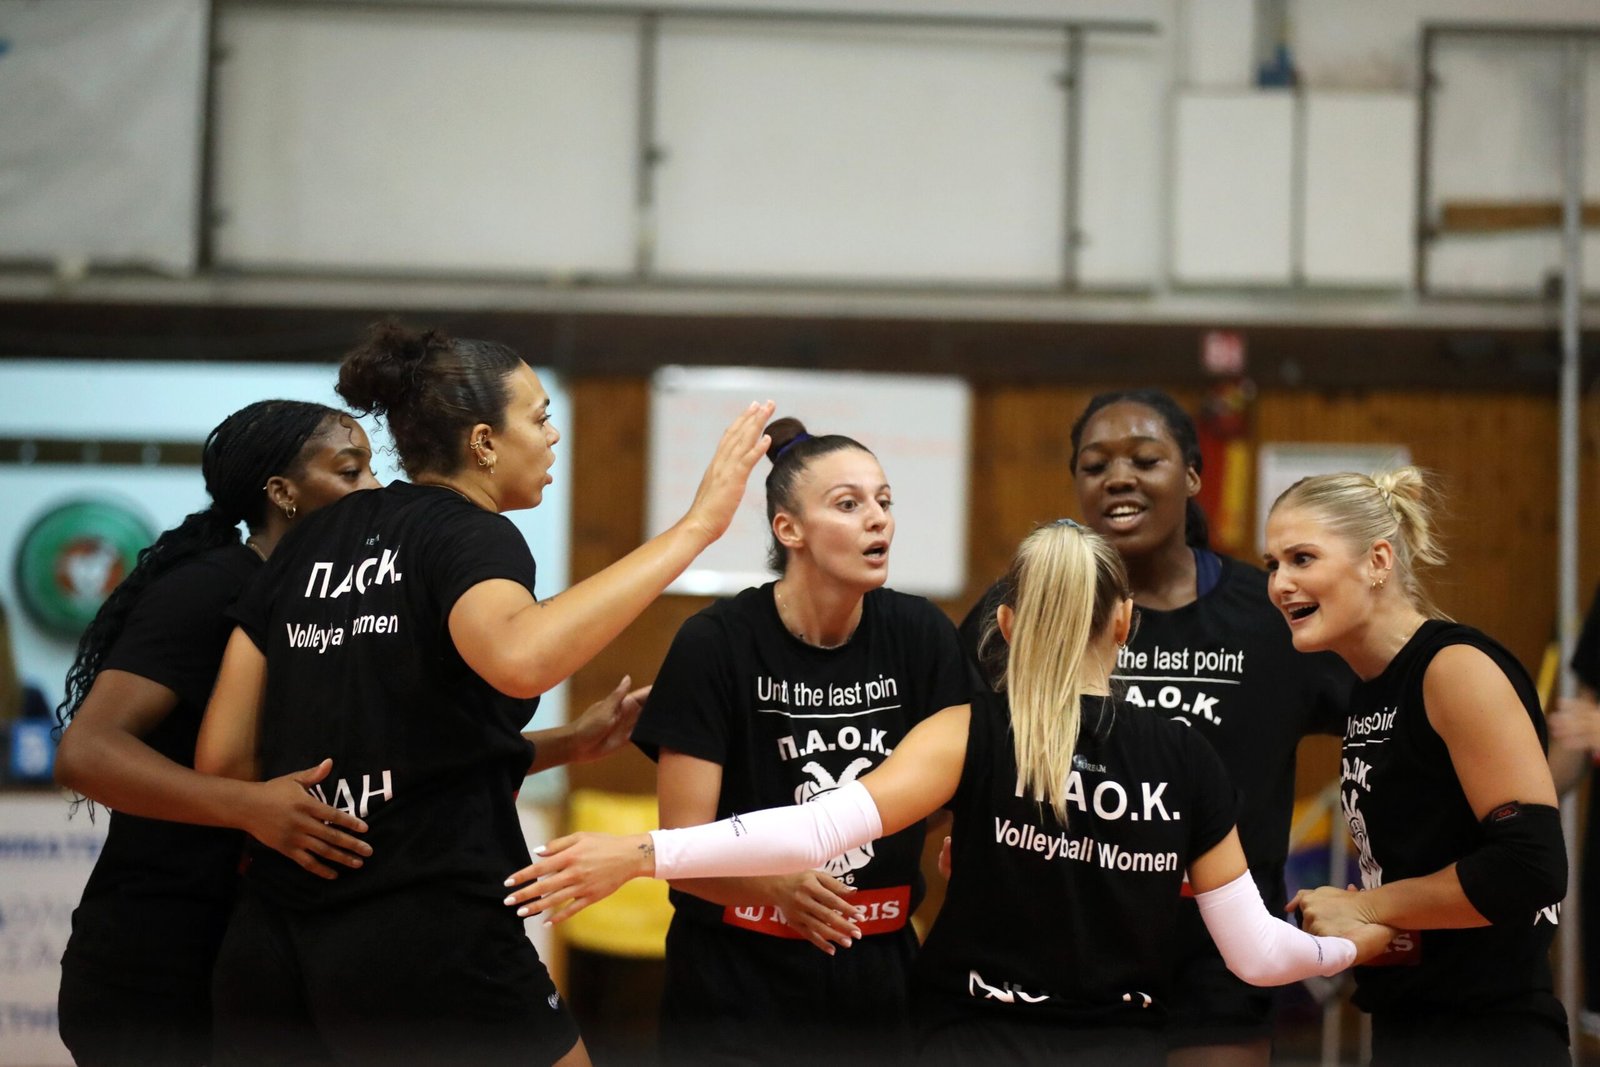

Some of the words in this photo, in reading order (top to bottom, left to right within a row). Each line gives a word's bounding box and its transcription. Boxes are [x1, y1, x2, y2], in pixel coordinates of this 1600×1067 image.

[1117, 645, 1148, 670] the
[1153, 645, 1189, 670] last
[1194, 647, 1244, 676] point
[794, 682, 824, 707] the
[829, 682, 863, 707] last
[995, 816, 1094, 863] Volleyball
[1098, 842, 1178, 872] Women
